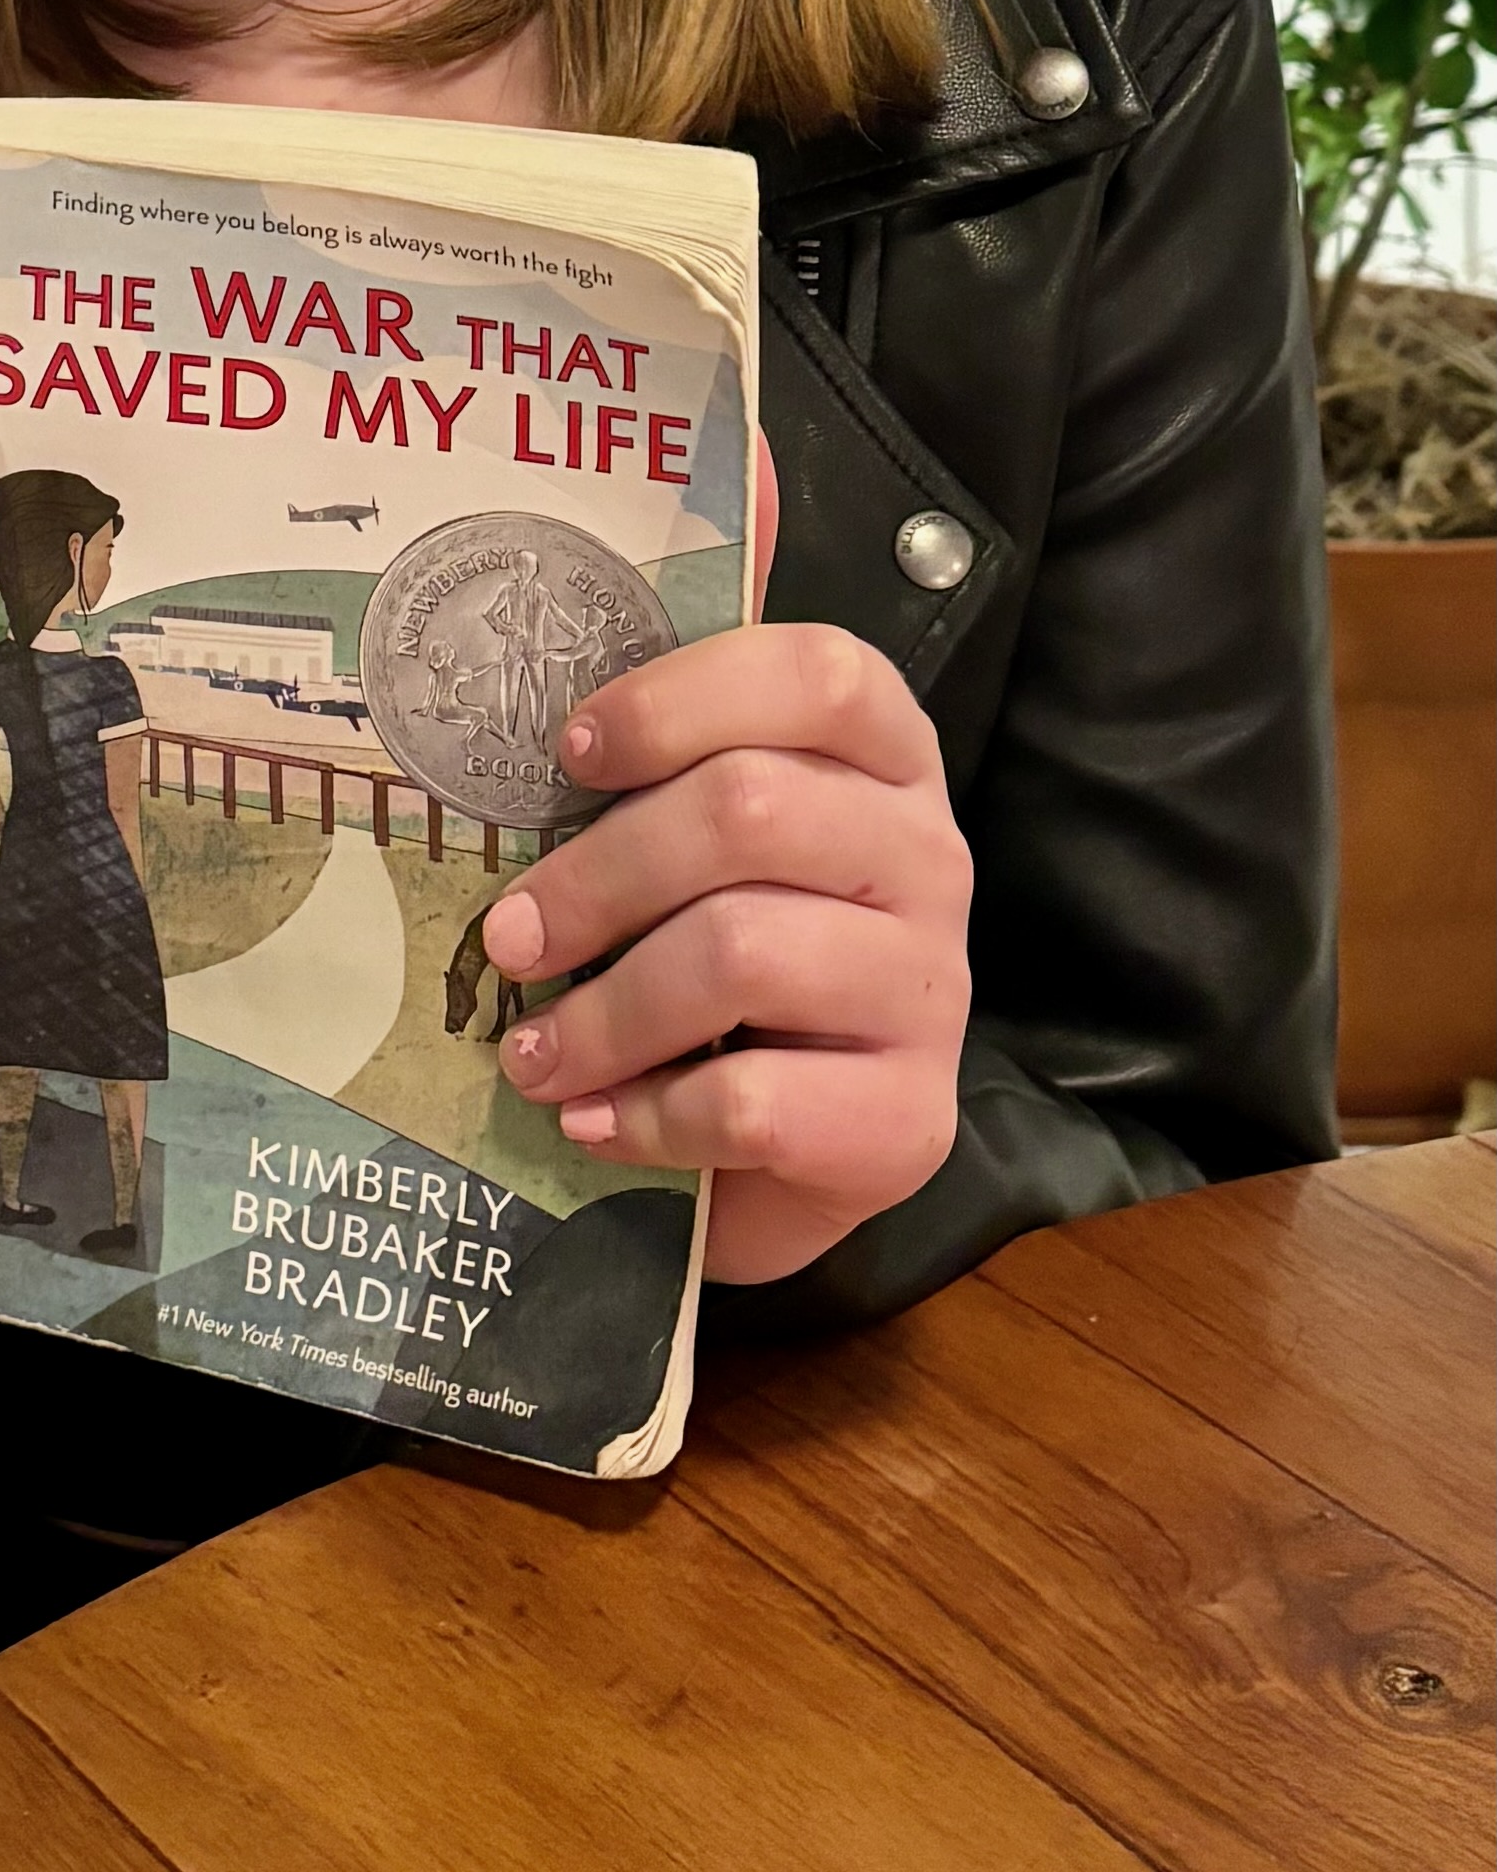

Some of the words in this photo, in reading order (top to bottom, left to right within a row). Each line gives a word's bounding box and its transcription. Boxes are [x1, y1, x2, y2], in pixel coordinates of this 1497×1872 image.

[52, 190, 135, 225] Finding
[140, 198, 210, 225] where
[215, 213, 255, 235] you
[262, 211, 339, 249] belong
[345, 225, 362, 244] is
[369, 226, 445, 261] always
[450, 245, 516, 268] worth
[522, 251, 559, 275] the
[565, 258, 613, 289] fight
[19, 265, 156, 333] THE
[189, 266, 425, 363] WAR
[456, 315, 650, 394] THAT
[323, 370, 478, 454] MY
[512, 393, 693, 486] LIFE
[397, 547, 516, 658] NEWBERY
[566, 566, 646, 671] HONO
[248, 1136, 516, 1231] KIMBERLY
[232, 1189, 513, 1297] BRUBAKER
[244, 1250, 490, 1349] BRADLEY
[157, 1302, 179, 1324] #1
[185, 1307, 233, 1338] New
[240, 1320, 284, 1351] York
[290, 1333, 348, 1369] Times
[351, 1347, 462, 1408] bestselling
[466, 1386, 539, 1419] author
